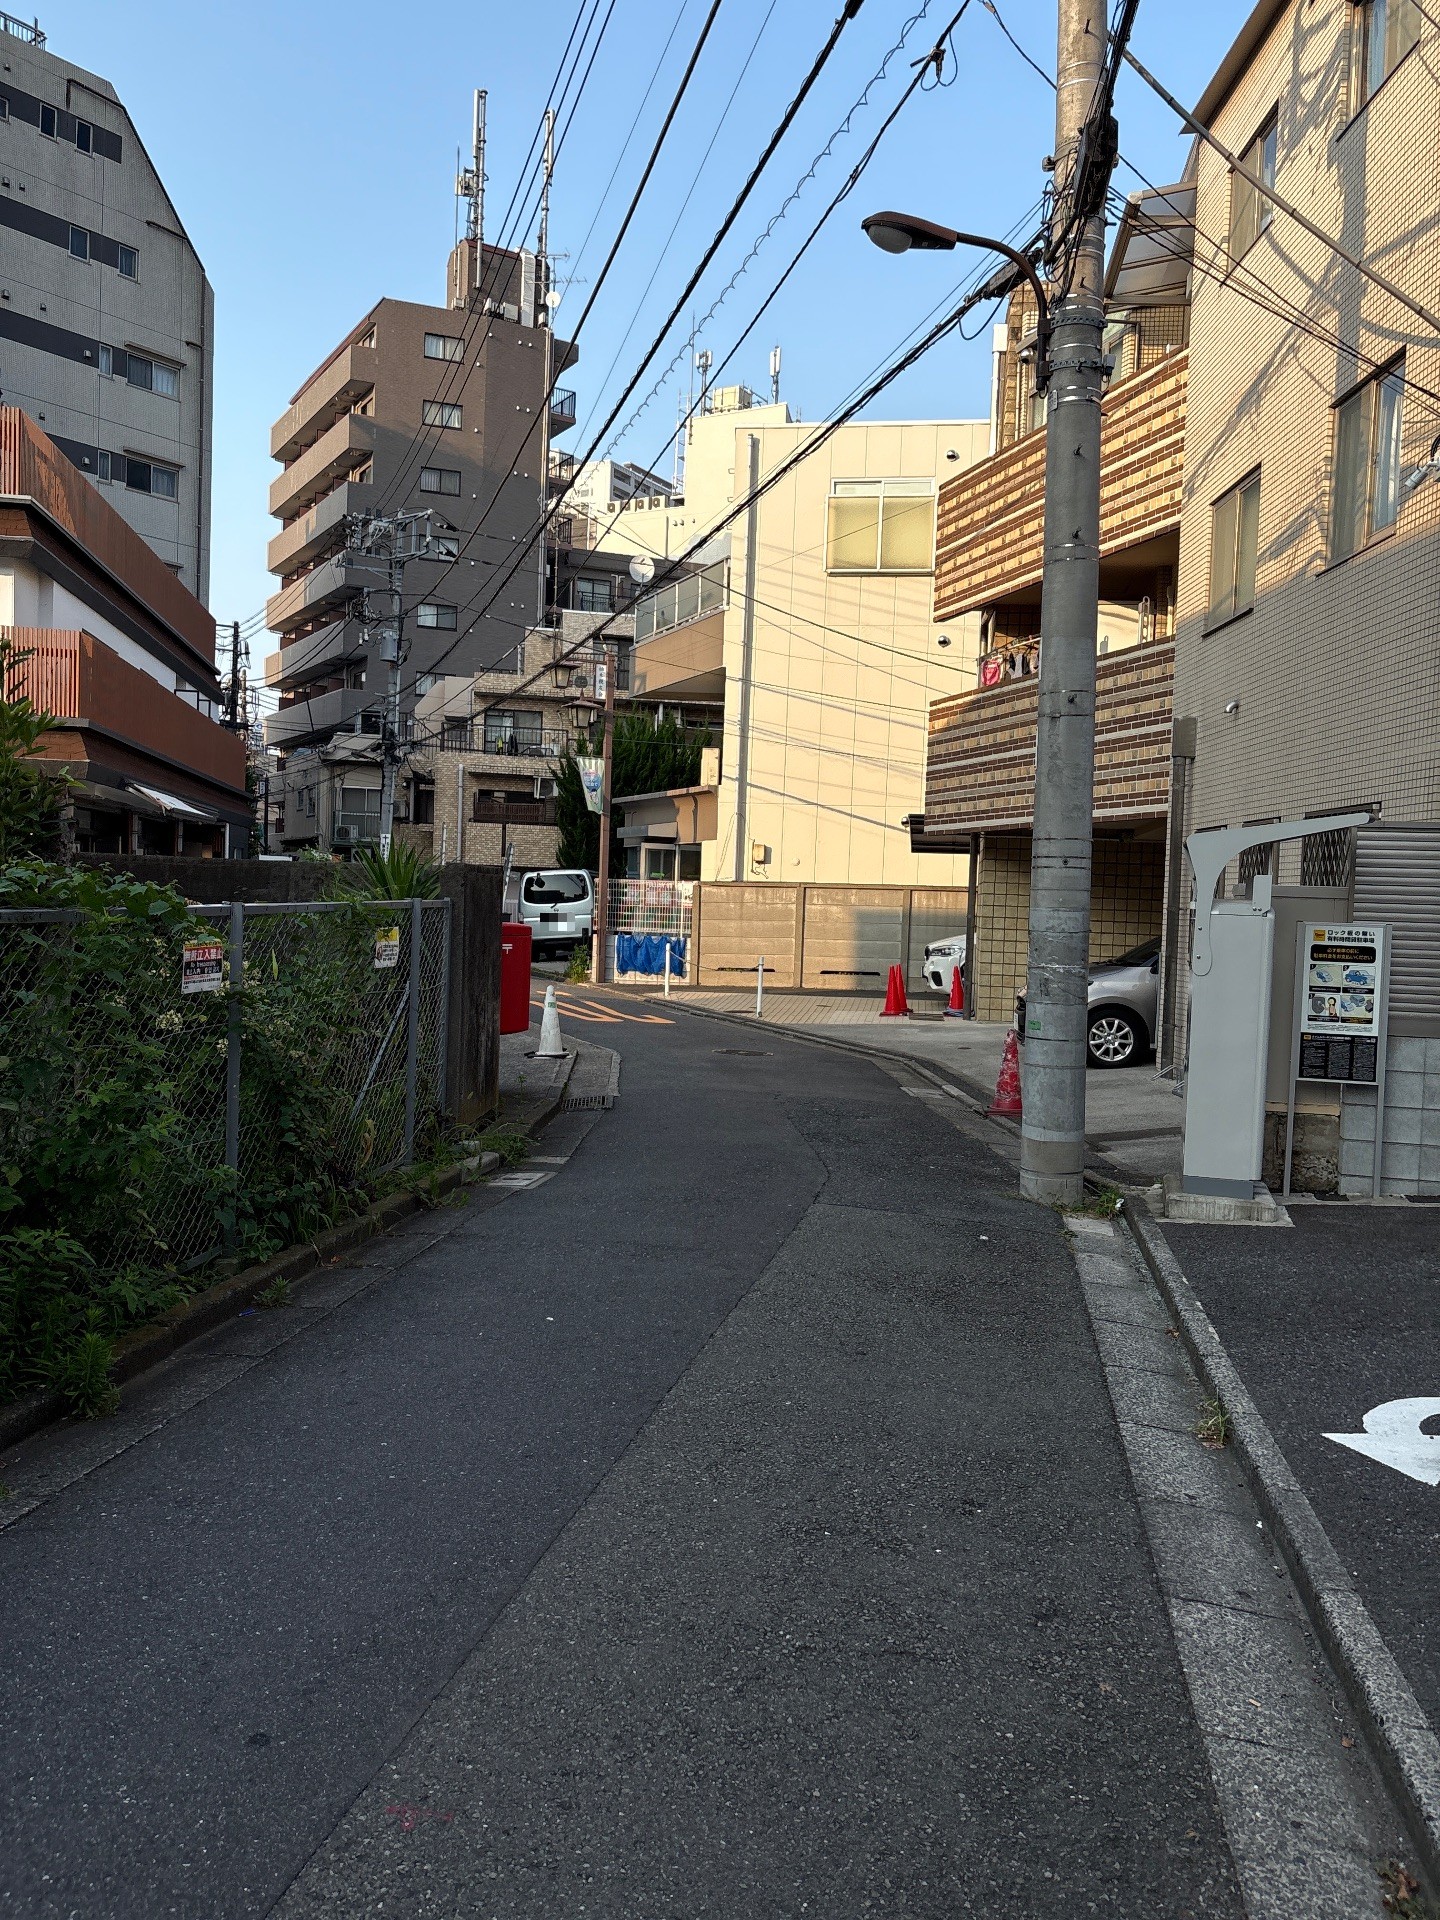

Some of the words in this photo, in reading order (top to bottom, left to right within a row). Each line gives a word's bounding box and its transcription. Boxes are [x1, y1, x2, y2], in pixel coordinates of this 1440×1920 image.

[1327, 929, 1376, 937] ロック板の無い
